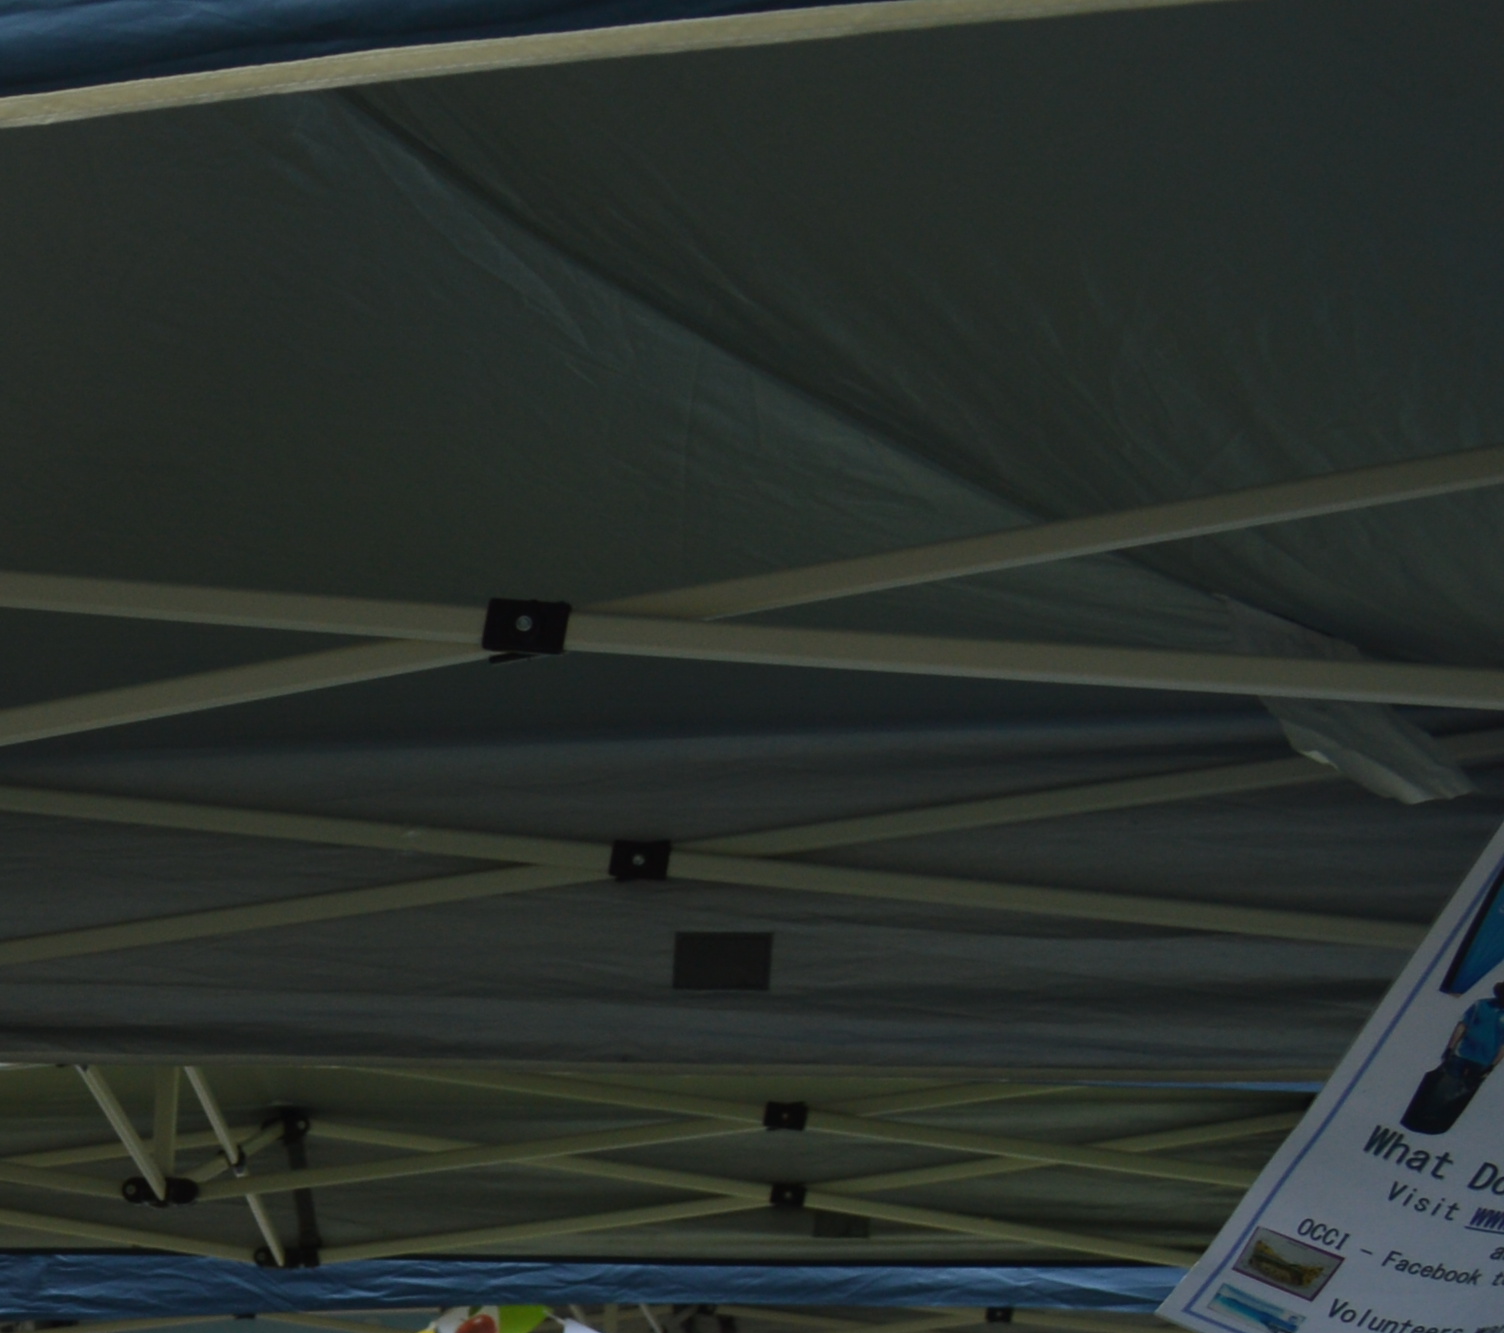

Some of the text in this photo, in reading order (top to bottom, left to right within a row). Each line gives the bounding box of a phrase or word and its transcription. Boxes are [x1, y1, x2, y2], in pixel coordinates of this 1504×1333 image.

[1363, 1124, 1453, 1180] What
[1387, 1181, 1460, 1221] Visit
[1297, 1218, 1350, 1250] OCCI
[1381, 1250, 1482, 1285] Facebook
